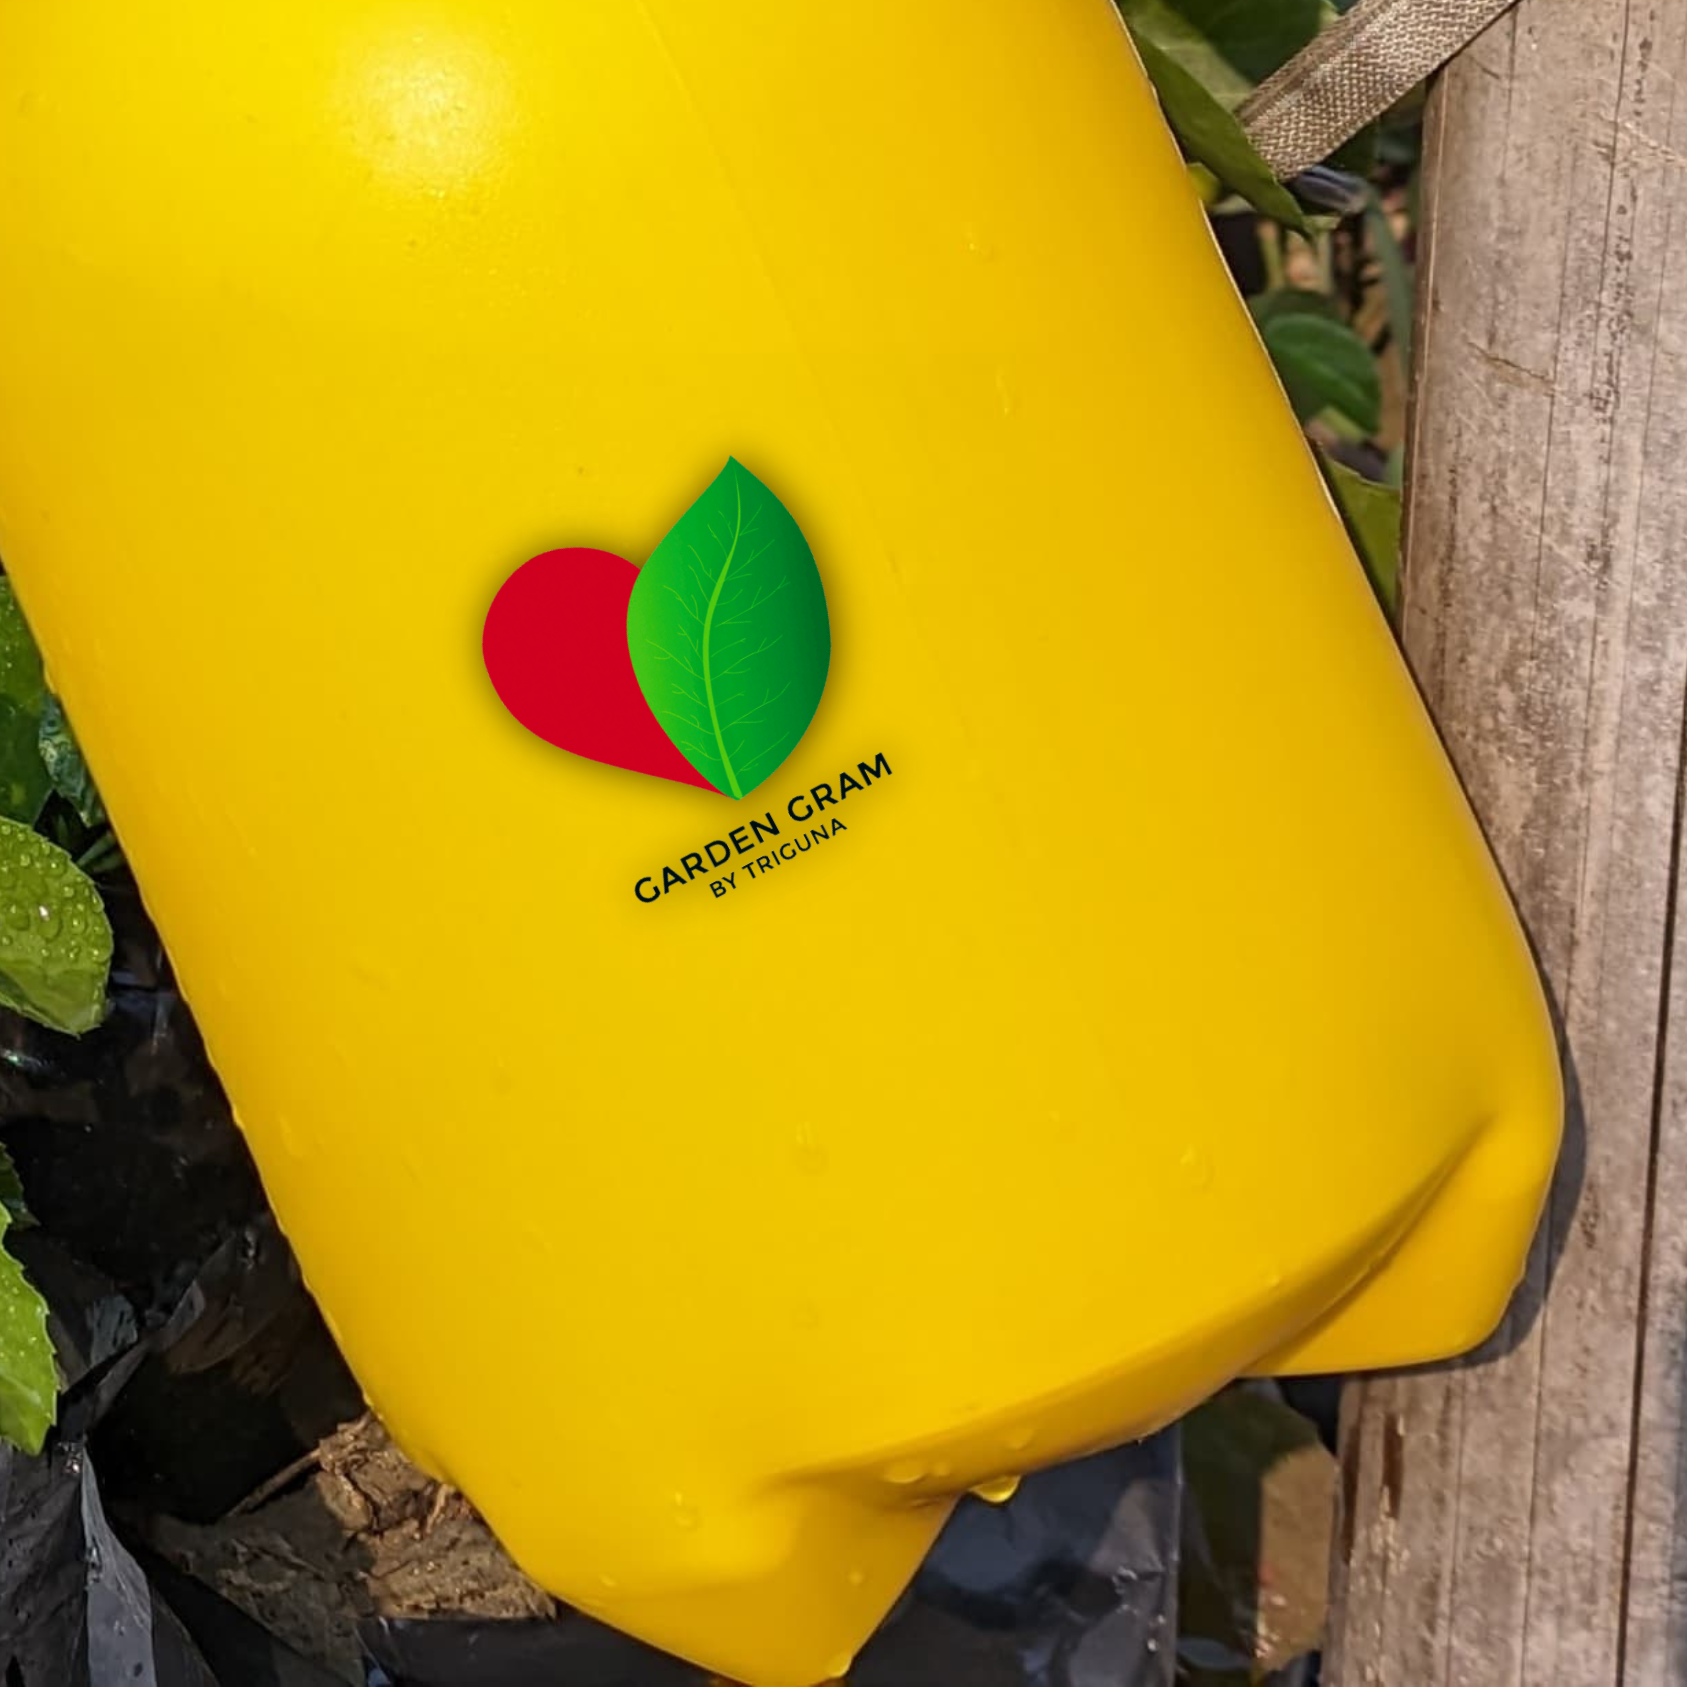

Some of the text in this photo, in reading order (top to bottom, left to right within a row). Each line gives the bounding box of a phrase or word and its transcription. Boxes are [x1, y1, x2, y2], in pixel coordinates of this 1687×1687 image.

[634, 752, 893, 903] GARDEN GRAM
[709, 817, 848, 899] BY TRIGUNA
